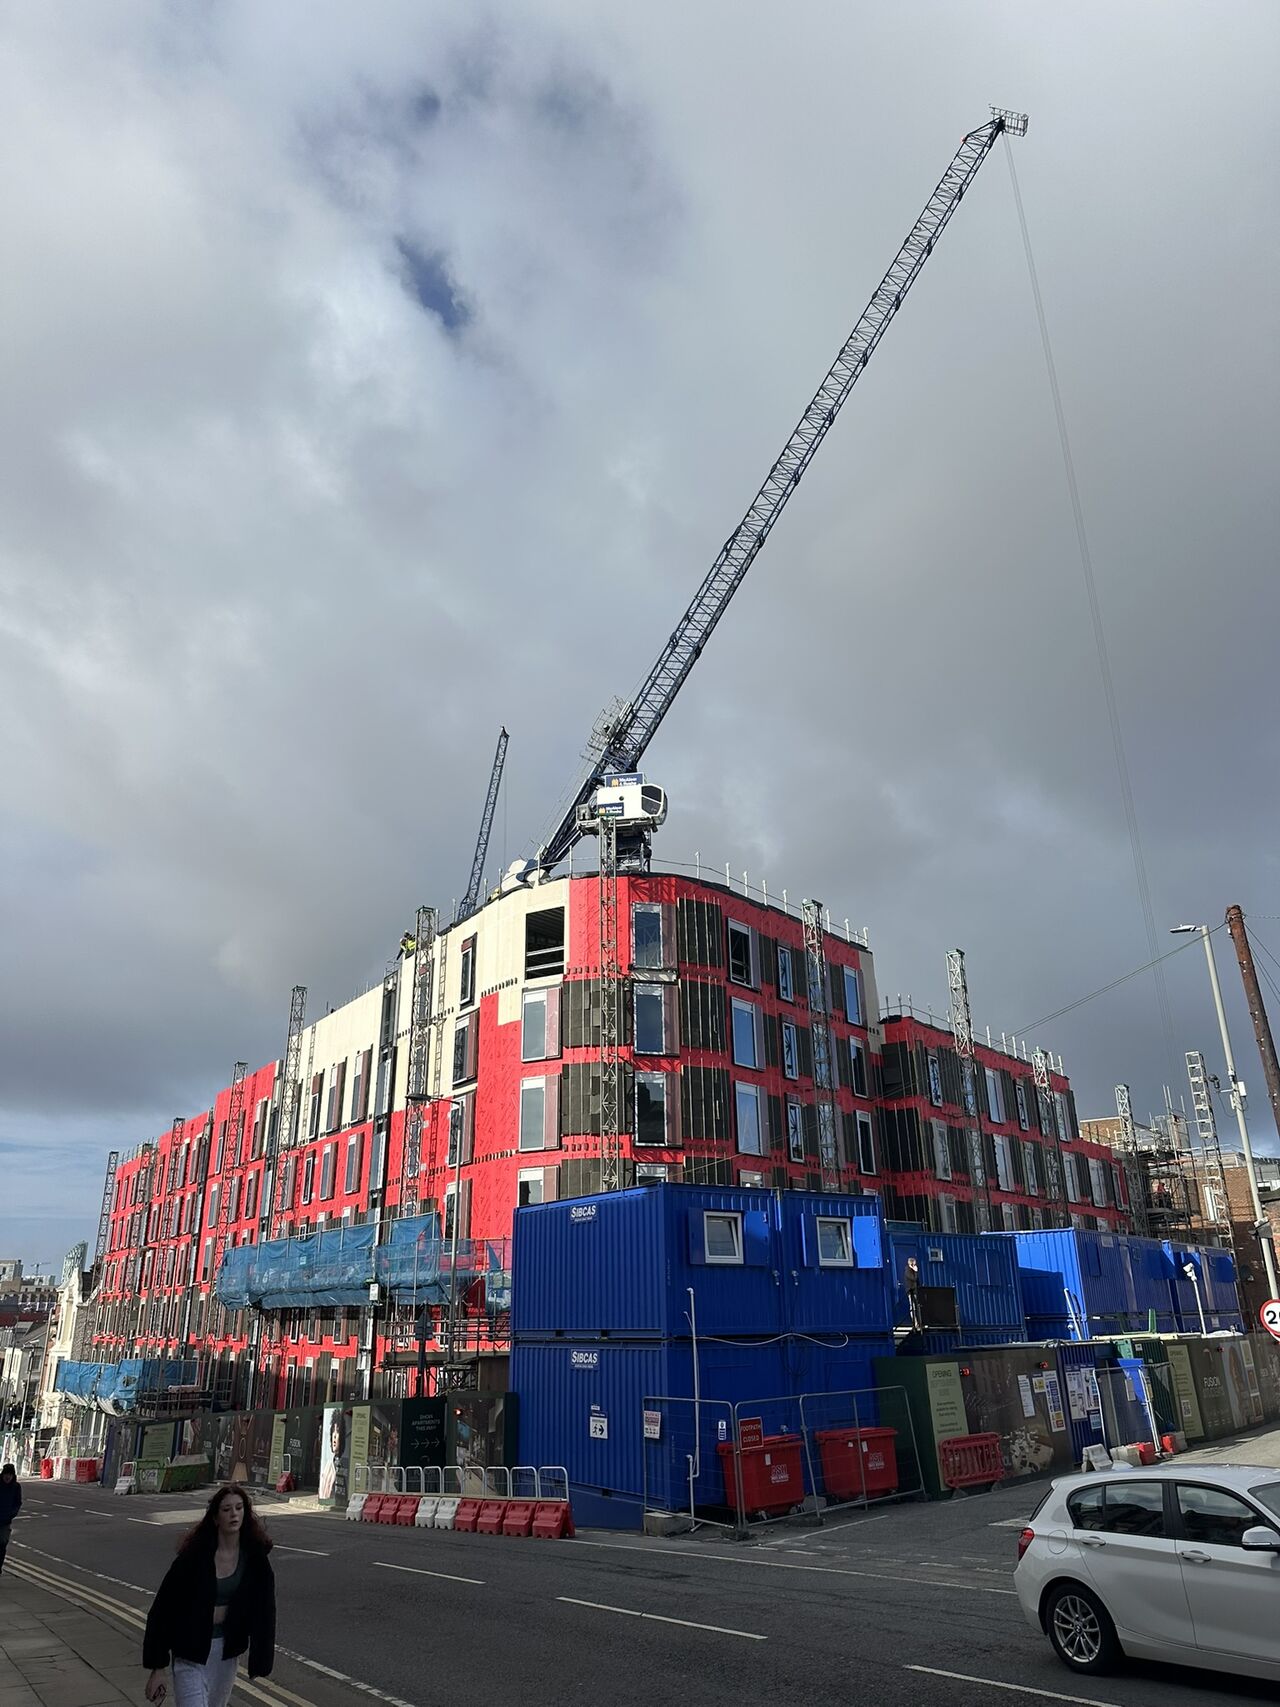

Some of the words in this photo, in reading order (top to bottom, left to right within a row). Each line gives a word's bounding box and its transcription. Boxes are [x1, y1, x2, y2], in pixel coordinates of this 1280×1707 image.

[571, 1205, 596, 1218] SIBCAS
[1266, 1310, 1280, 1324] 2
[571, 1351, 598, 1364] SIBCAS
[743, 1435, 760, 1443] CLOSED
